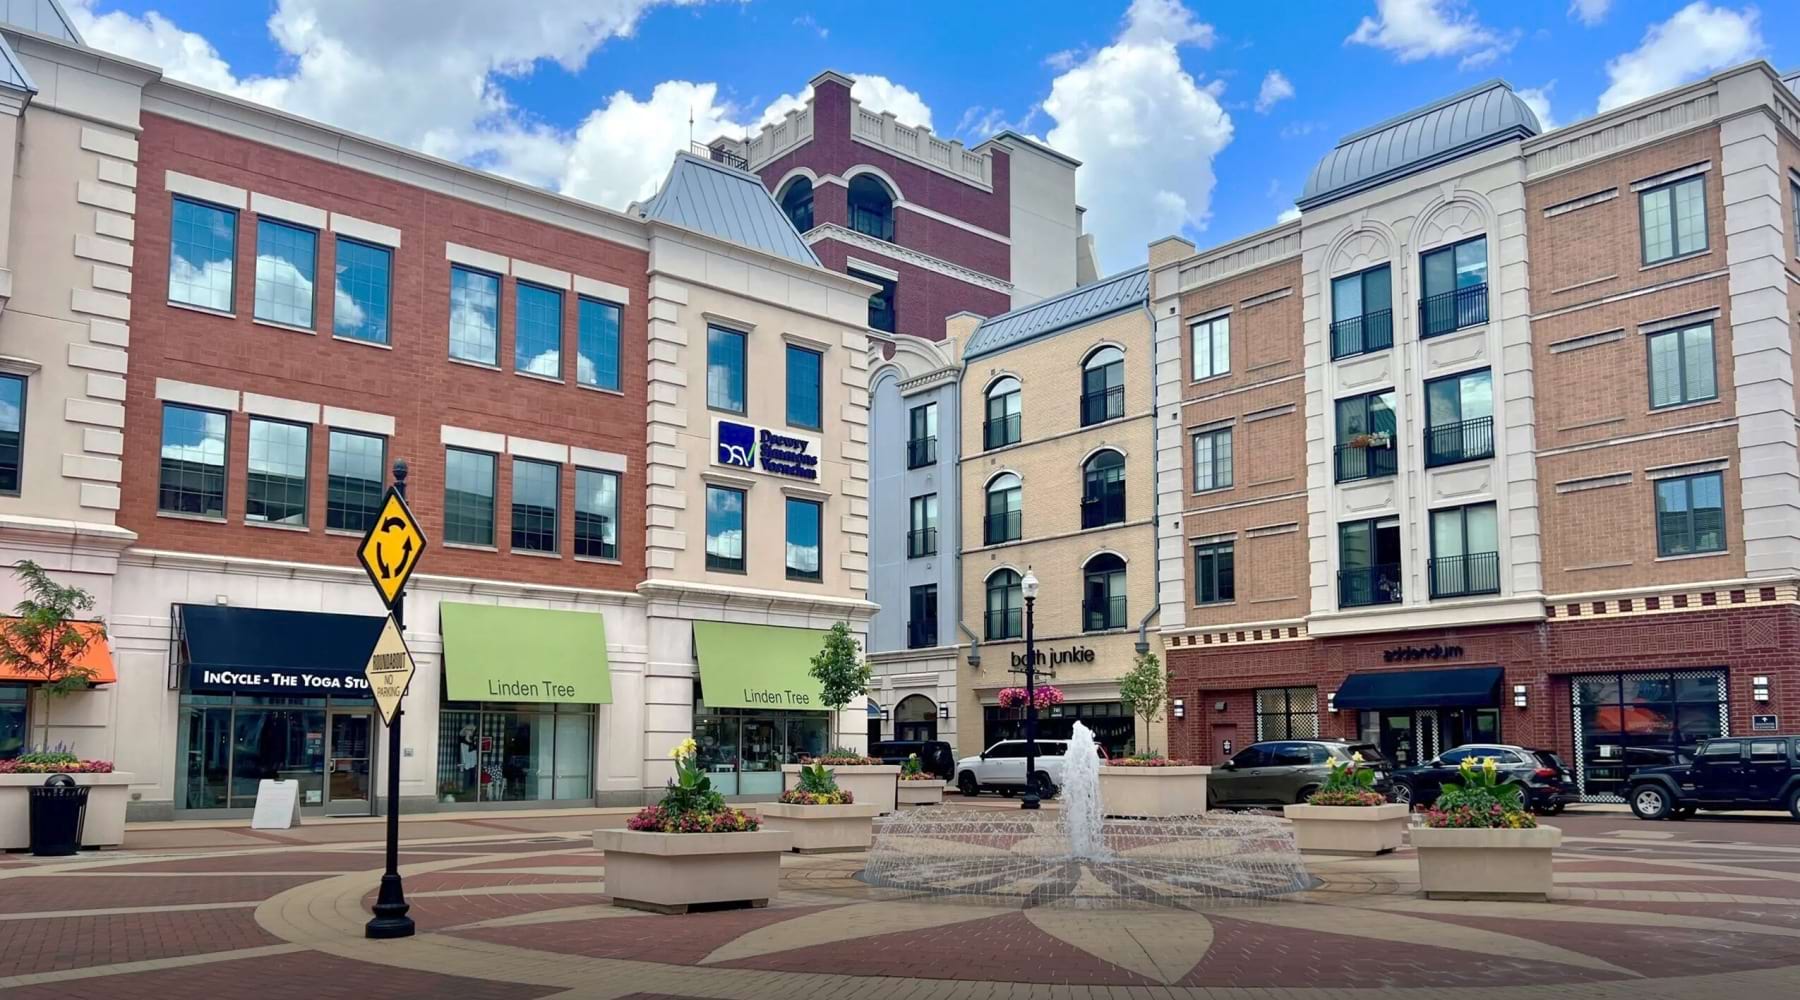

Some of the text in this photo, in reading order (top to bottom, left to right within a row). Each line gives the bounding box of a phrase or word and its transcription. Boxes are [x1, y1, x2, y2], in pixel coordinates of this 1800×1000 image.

[1048, 645, 1096, 669] junkie
[1383, 644, 1464, 663] addendum
[384, 674, 394, 686] NO
[488, 679, 576, 698] Linden Tree
[376, 686, 401, 698] PARKING
[743, 688, 810, 706] Linden Tree
